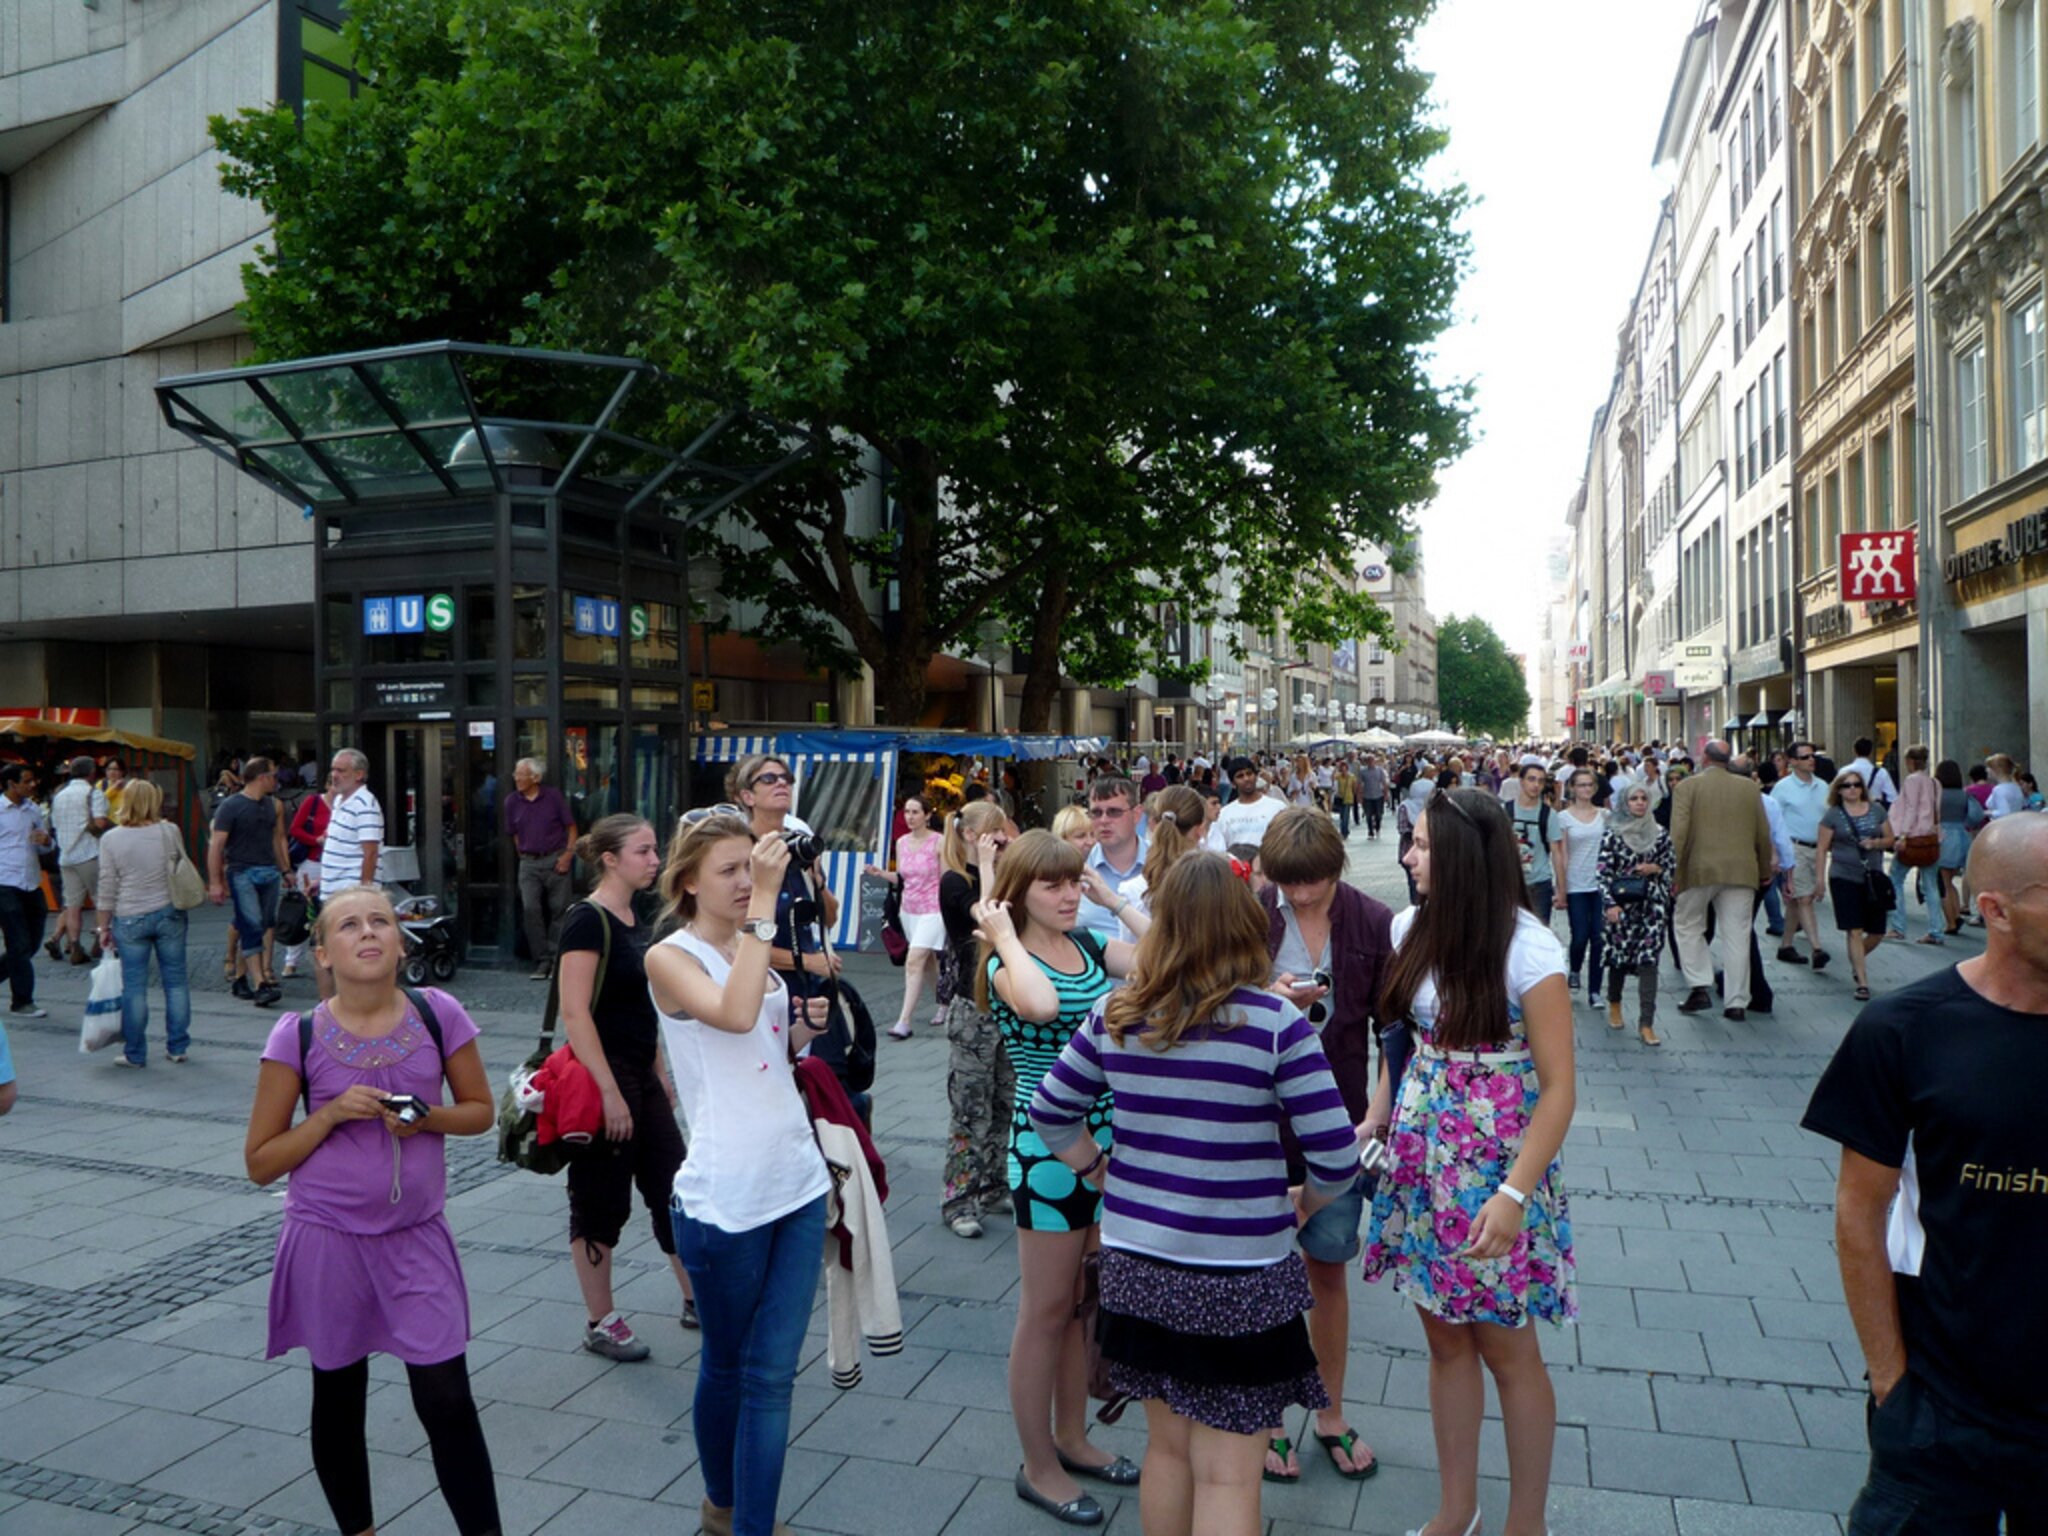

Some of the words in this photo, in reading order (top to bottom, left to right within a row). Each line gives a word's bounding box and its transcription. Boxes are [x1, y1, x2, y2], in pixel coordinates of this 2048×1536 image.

[400, 601, 418, 628] U
[431, 598, 451, 627] S
[602, 605, 616, 631] U
[631, 609, 645, 635] S
[1960, 1163, 2048, 1193] Finish
